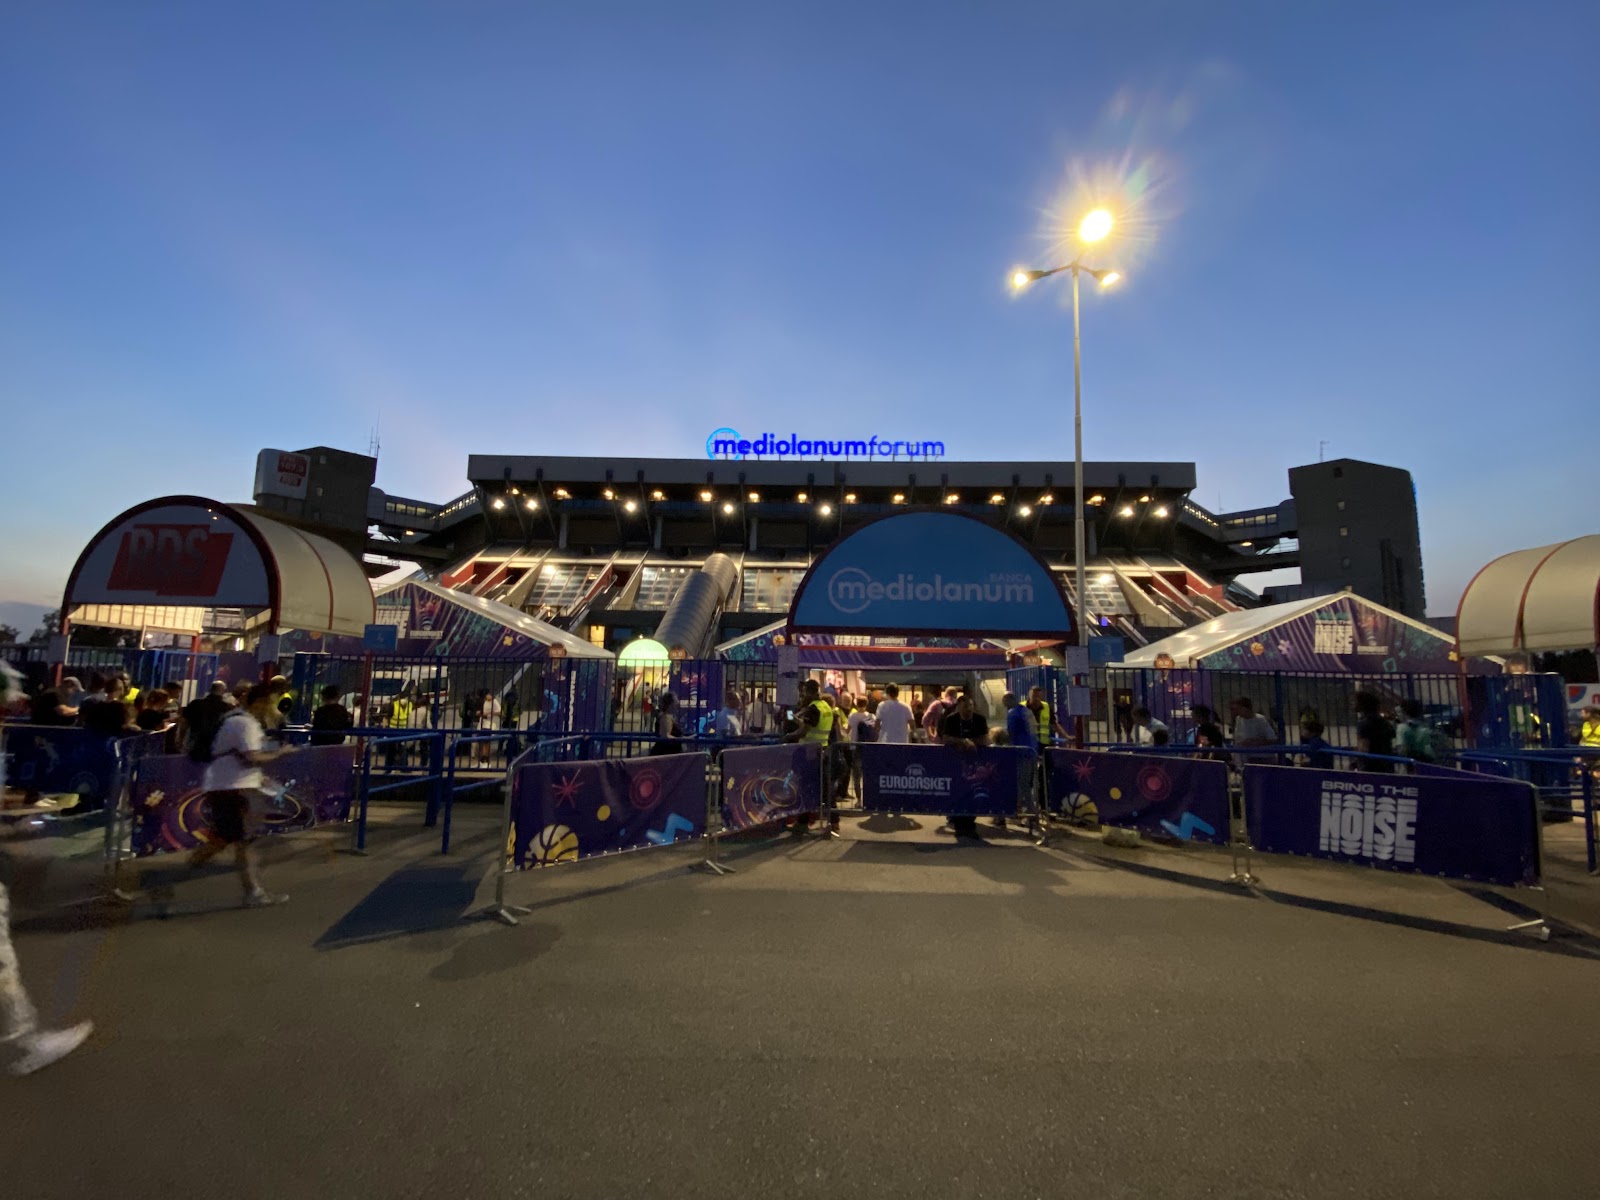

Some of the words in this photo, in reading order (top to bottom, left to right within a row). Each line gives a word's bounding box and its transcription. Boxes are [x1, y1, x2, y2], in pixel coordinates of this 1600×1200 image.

[836, 573, 1034, 604] mediolanum
[879, 775, 953, 791] EUROBASKET
[1321, 780, 1375, 793] BRING
[1380, 785, 1419, 797] THE
[1319, 791, 1418, 863] NOISE
